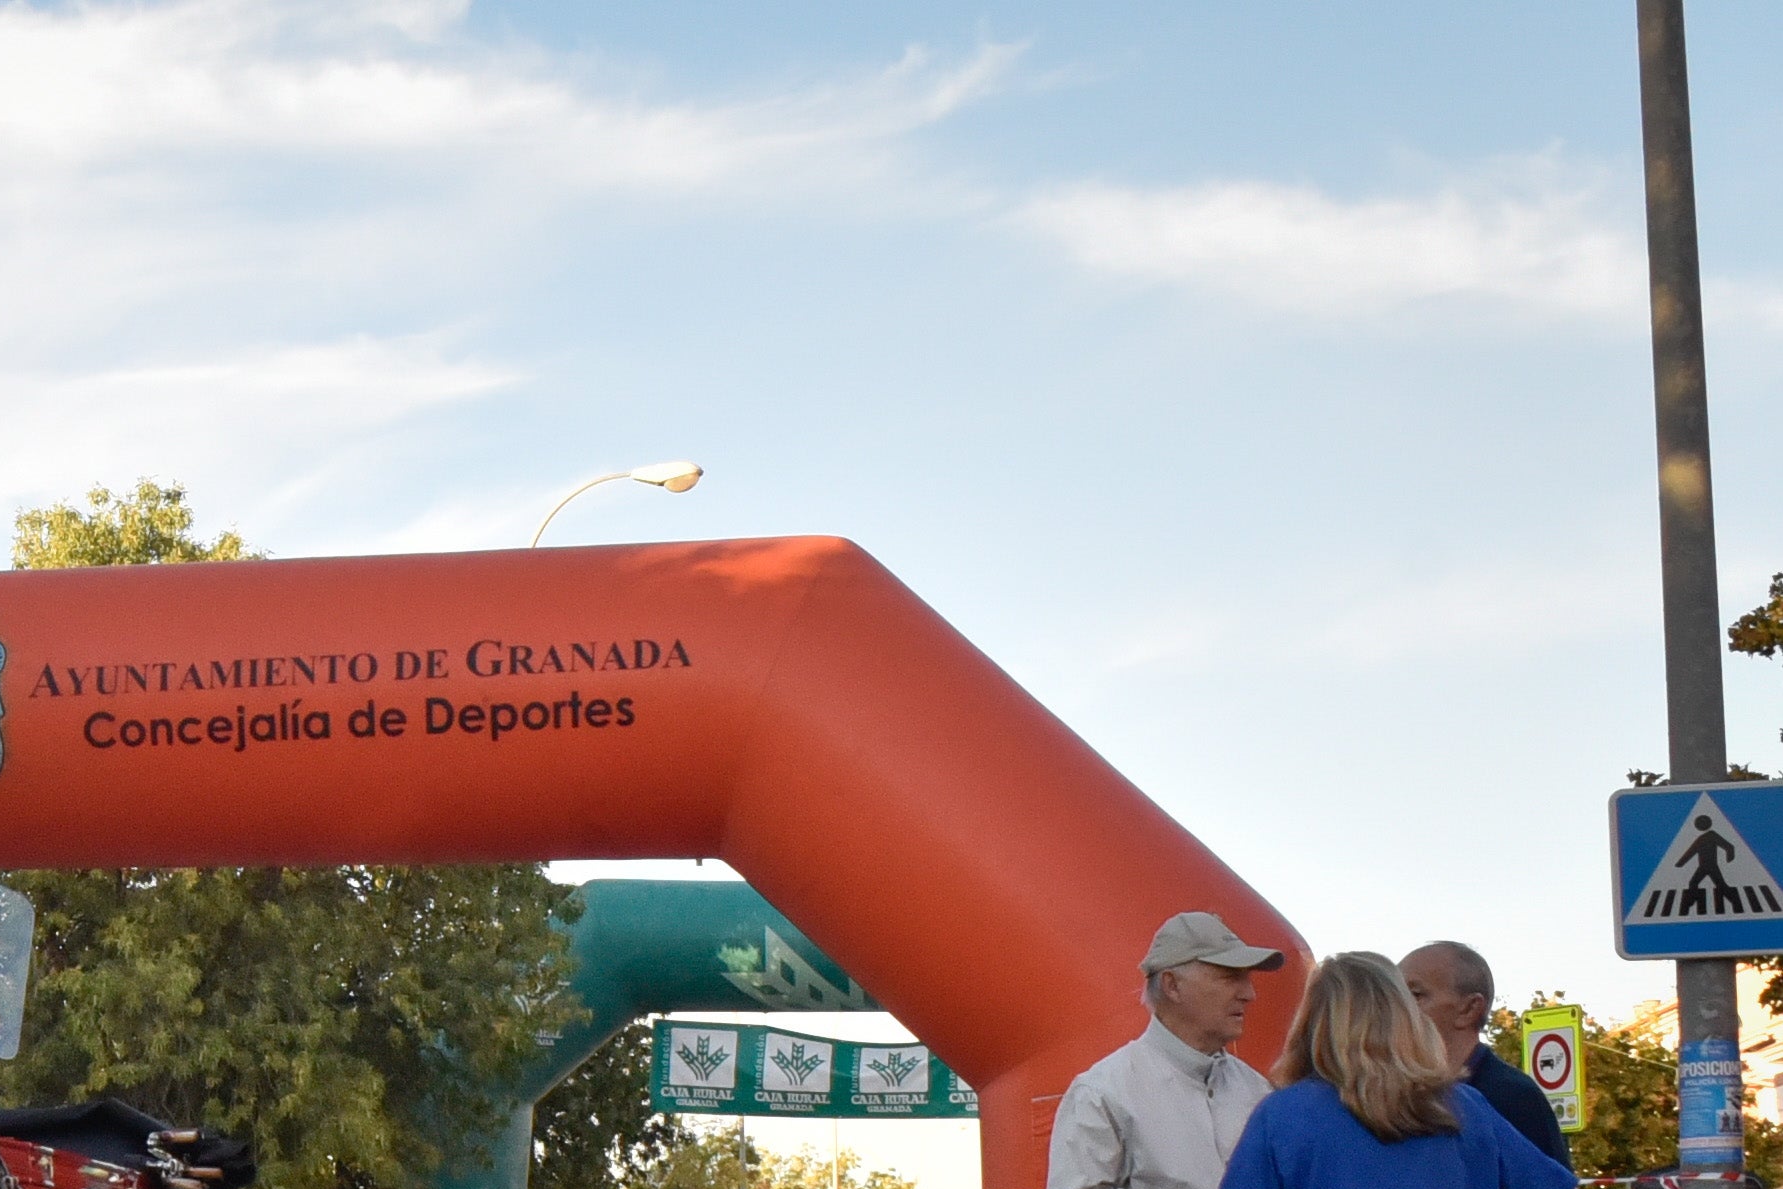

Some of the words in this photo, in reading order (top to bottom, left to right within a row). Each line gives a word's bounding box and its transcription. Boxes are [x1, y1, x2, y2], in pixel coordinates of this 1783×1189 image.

[28, 651, 379, 698] AYUNTAMIENTO
[394, 649, 450, 681] DE
[466, 638, 693, 677] GRANADA
[83, 698, 331, 752] Concejalía
[348, 699, 407, 738] de
[425, 690, 635, 741] Deportes
[660, 1086, 690, 1098] CAJA
[692, 1088, 735, 1100] RURAL
[754, 1091, 784, 1103] CAJA
[787, 1092, 831, 1104] RURAL
[675, 1099, 719, 1107] GRANADA
[851, 1094, 878, 1105] CAJA
[884, 1094, 929, 1105] RURAL
[769, 1103, 815, 1111] GRANADA
[867, 1104, 913, 1113] GRANADA
